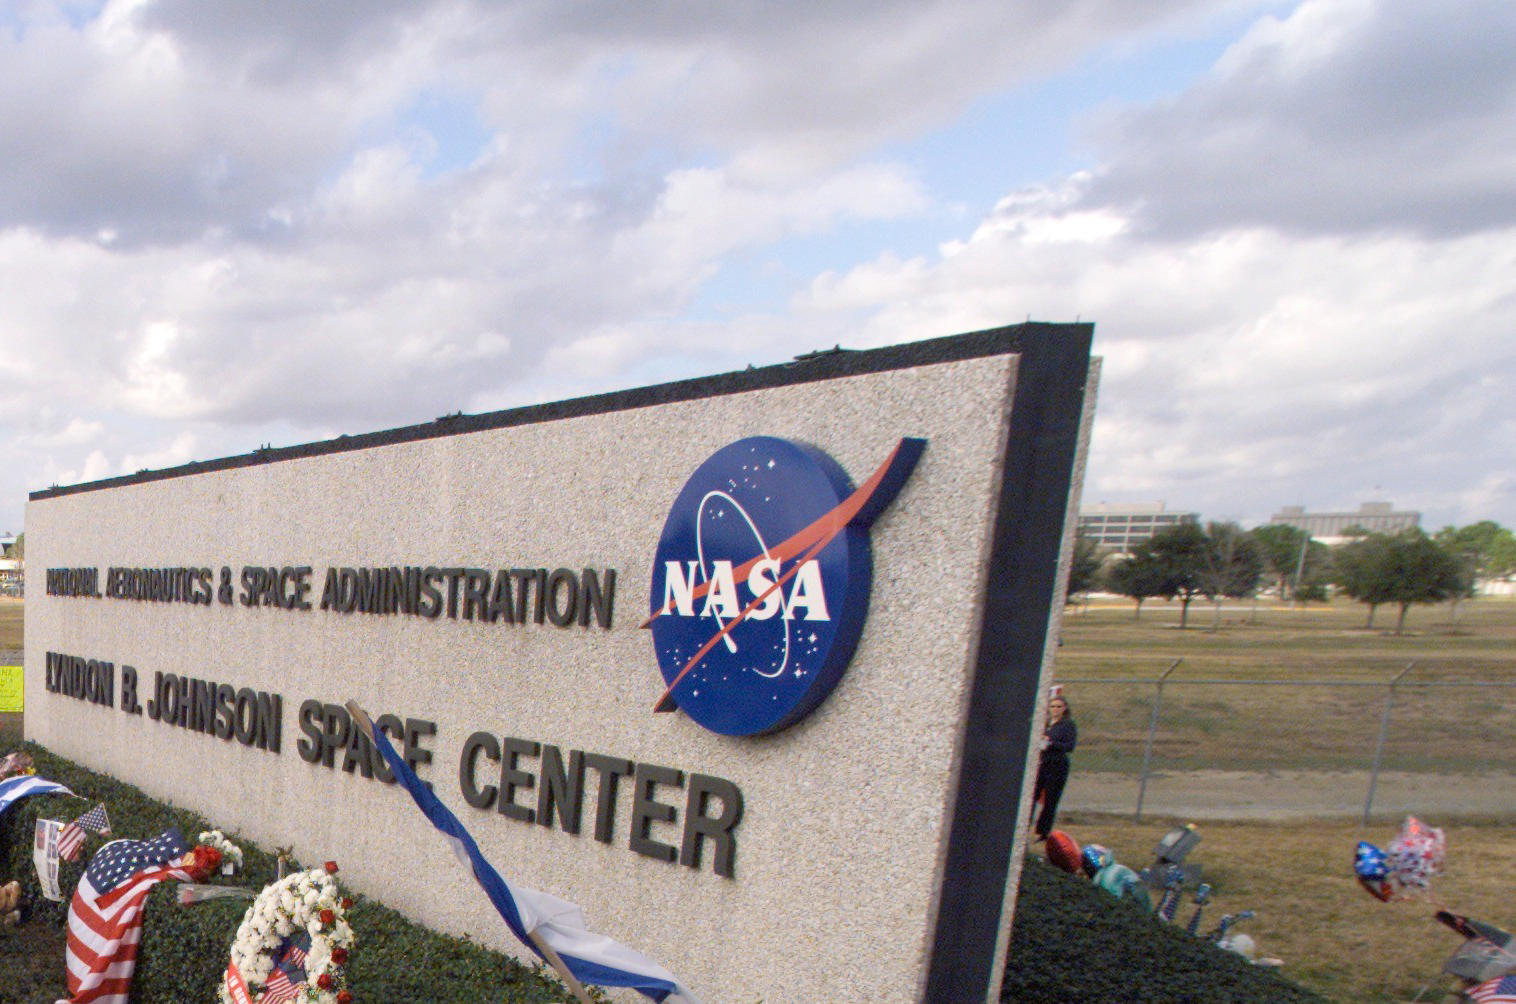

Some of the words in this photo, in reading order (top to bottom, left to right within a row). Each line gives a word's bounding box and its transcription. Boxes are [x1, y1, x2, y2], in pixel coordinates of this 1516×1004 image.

[46, 567, 102, 598] NATIONAL
[106, 566, 213, 605] AERONAUTICS
[218, 566, 233, 604] &
[240, 566, 312, 610] SPACE
[320, 566, 615, 629] ADMINISTRATION
[659, 557, 831, 621] NASA
[46, 651, 114, 707] LYNDON
[121, 665, 142, 715] B.
[147, 671, 281, 754] JOHNSON
[297, 699, 437, 791] SPACE
[459, 731, 744, 879] CENTER
